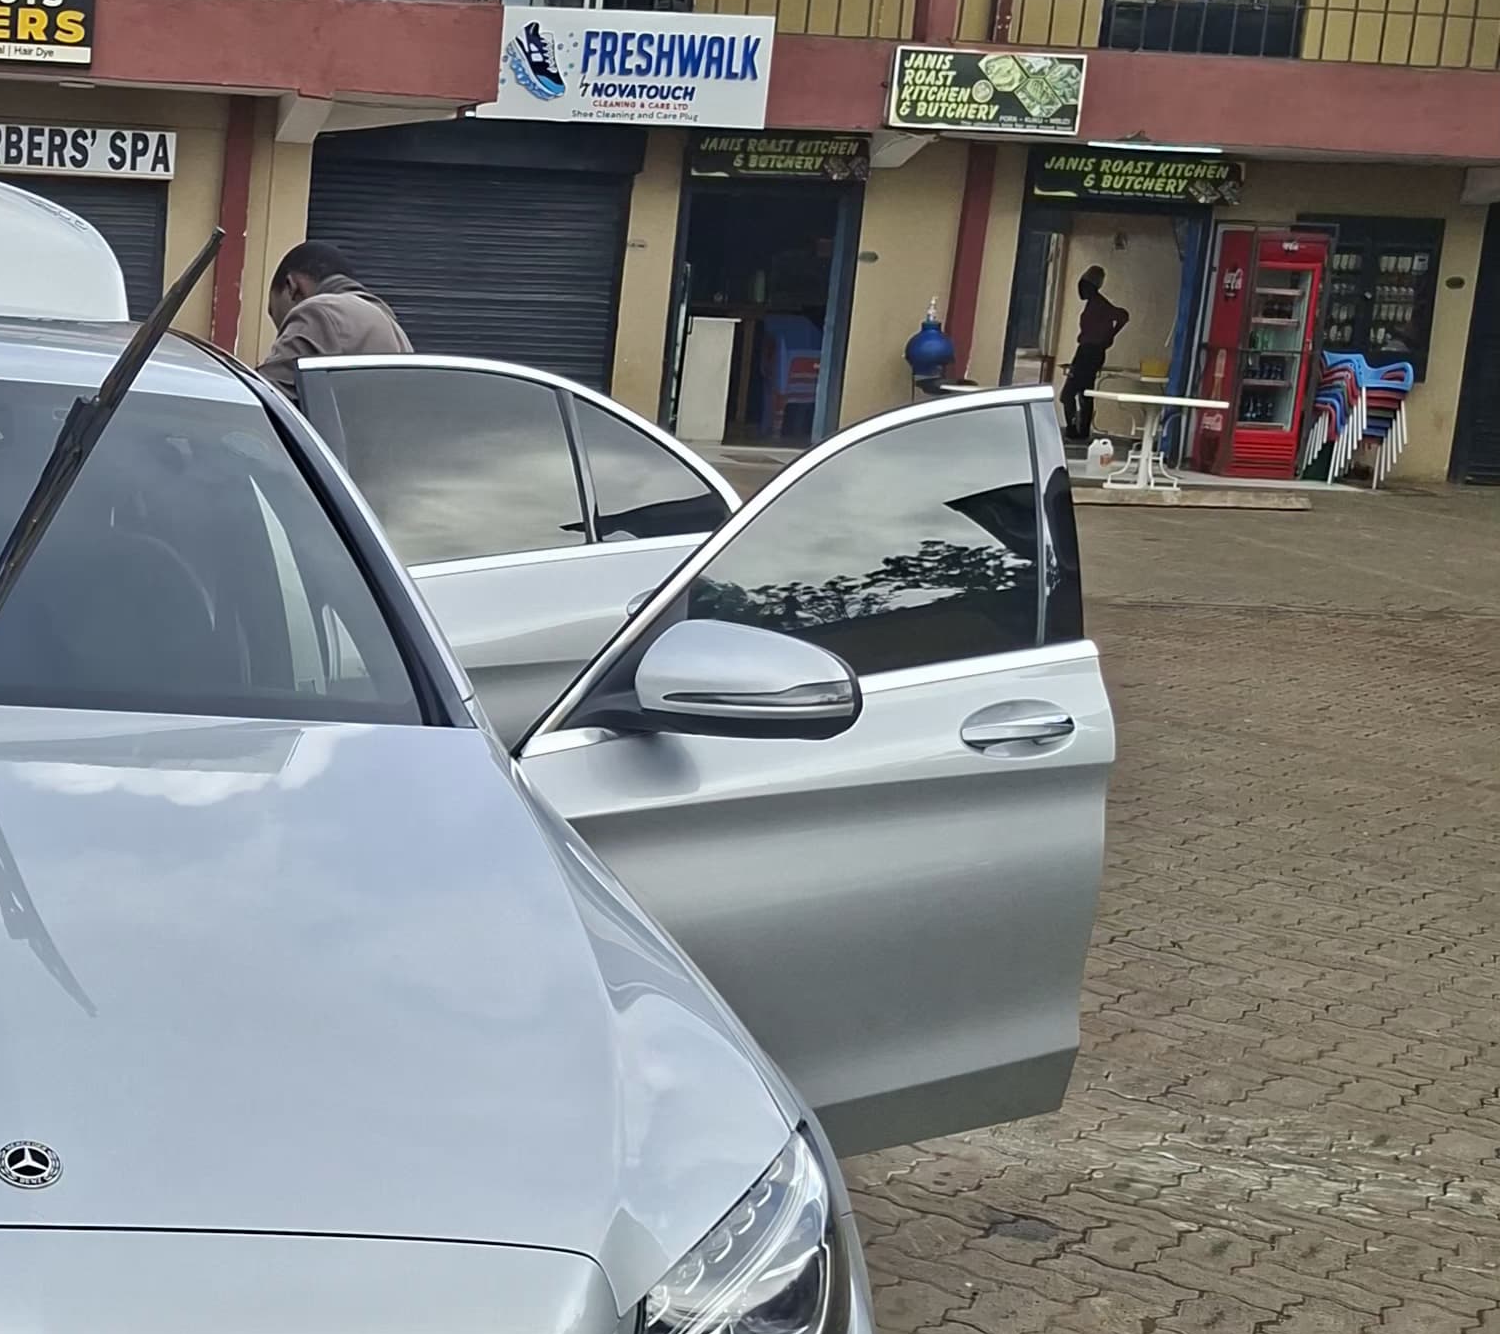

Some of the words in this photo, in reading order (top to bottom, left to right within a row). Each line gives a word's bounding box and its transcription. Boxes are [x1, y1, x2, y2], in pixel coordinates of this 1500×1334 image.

[14, 46, 34, 56] Hair
[36, 47, 54, 58] Dye
[581, 30, 762, 81] FRESHWALK
[904, 53, 954, 68] JANIS
[903, 69, 956, 86] ROAST
[591, 82, 695, 101] NOVATOUCH
[900, 85, 971, 102] KITCHEN
[592, 100, 636, 108] CLEANING
[648, 102, 670, 110] CARE
[899, 101, 912, 116] &
[916, 103, 1000, 121] BUTCHERY
[572, 109, 594, 118] Shoe
[596, 110, 634, 121] Cleaning
[637, 111, 653, 119] and
[656, 112, 677, 120] Care
[680, 112, 698, 122] Plug
[108, 131, 171, 174] SPA
[700, 137, 744, 151] JANIS
[747, 138, 795, 152] ROAST
[796, 140, 859, 156] KITCHEN
[748, 154, 824, 170] BUTCHERY
[1044, 157, 1096, 172] JANIS
[1100, 159, 1154, 176] ROAST
[1156, 162, 1229, 180] KITCHEN
[1083, 173, 1096, 187] &
[1101, 175, 1188, 194] BUTCHERY
